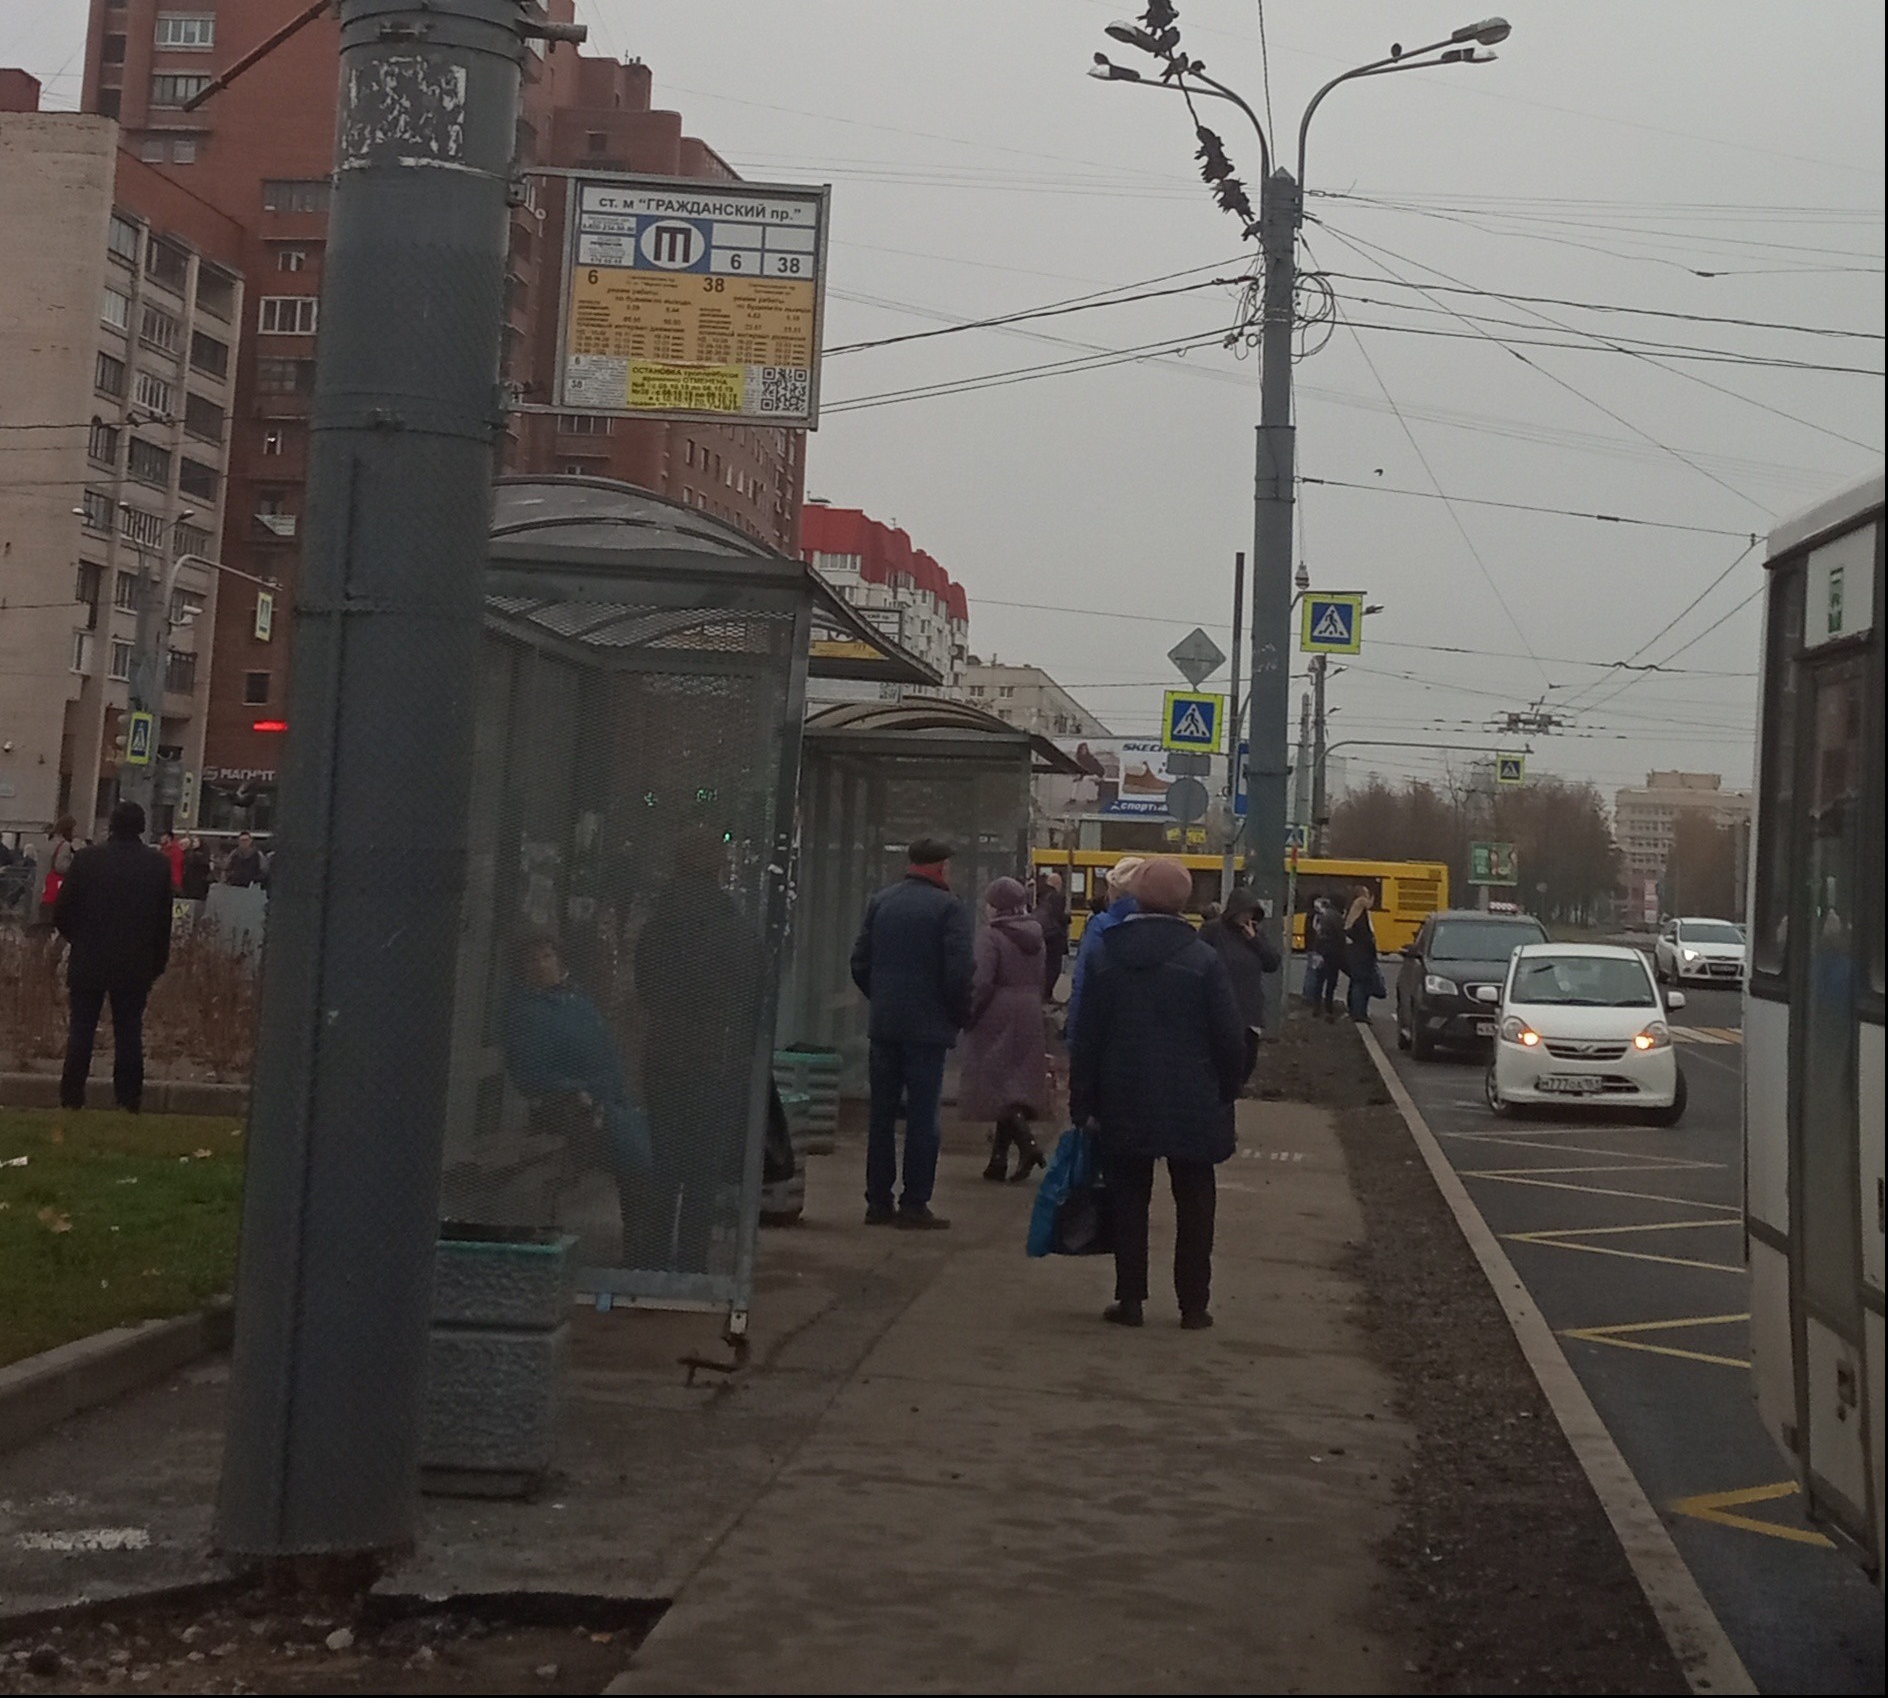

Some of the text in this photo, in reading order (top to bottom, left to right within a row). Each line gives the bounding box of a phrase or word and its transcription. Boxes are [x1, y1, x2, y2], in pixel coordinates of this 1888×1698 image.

[599, 197, 618, 209] ст.
[623, 200, 634, 209] м
[730, 254, 800, 274] 6 38
[588, 270, 725, 293] 6 38
